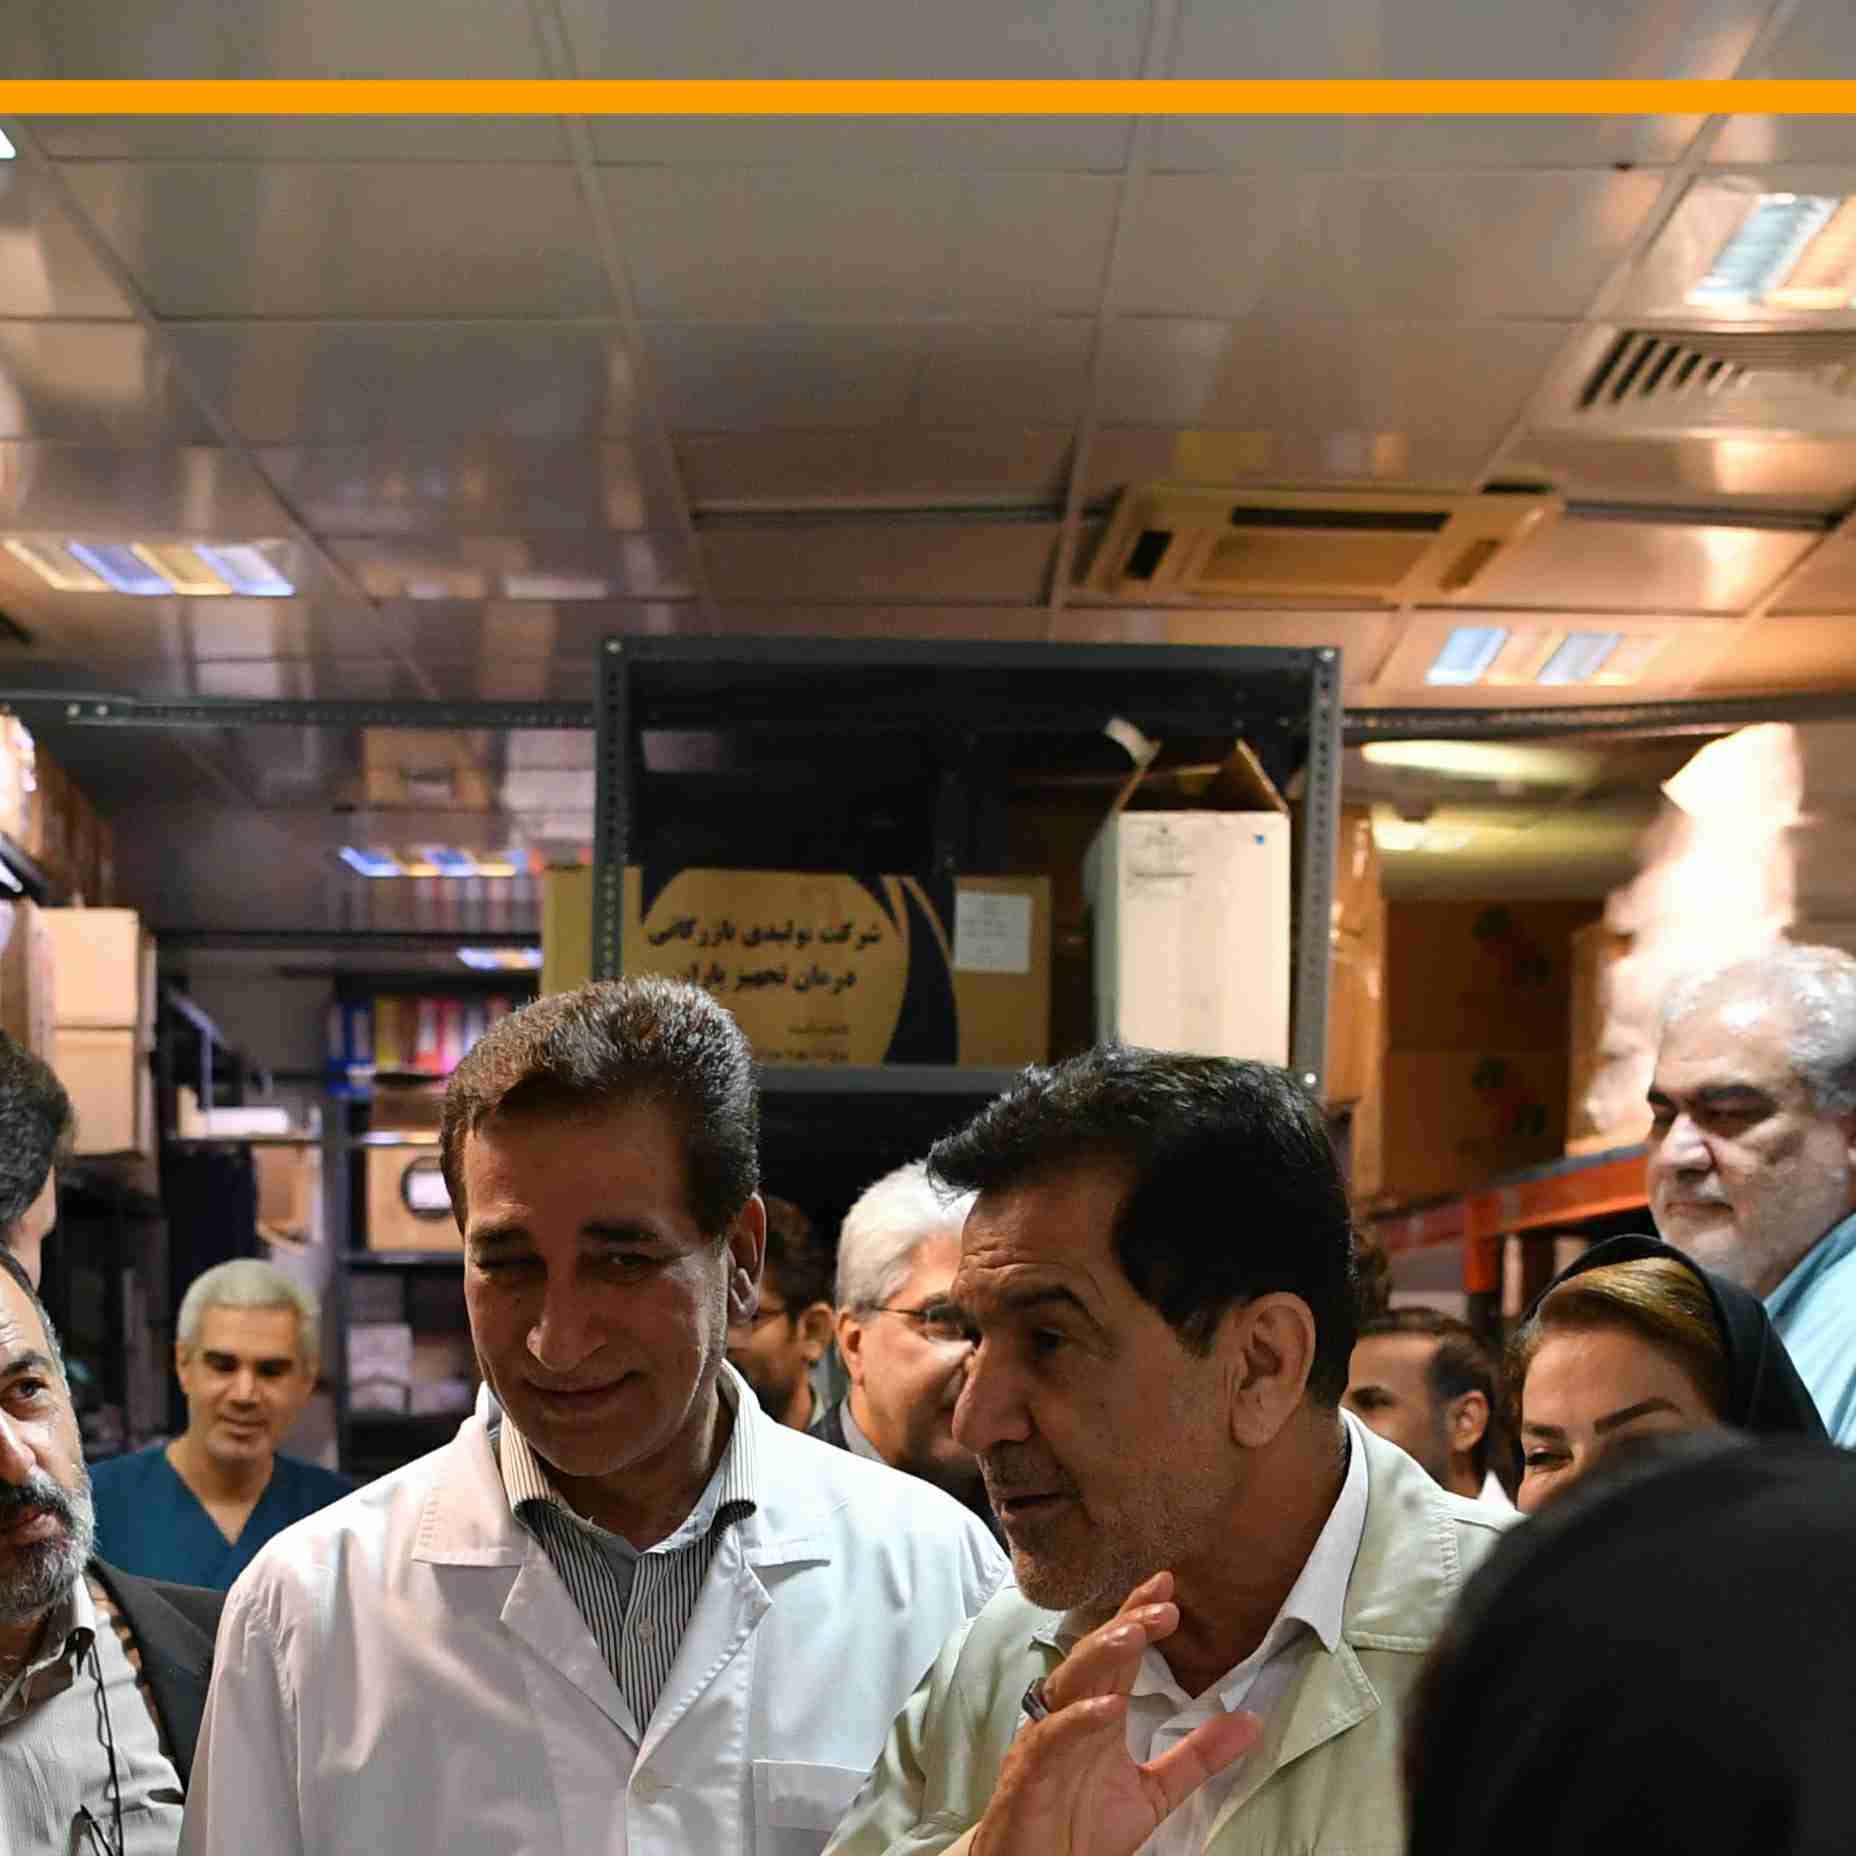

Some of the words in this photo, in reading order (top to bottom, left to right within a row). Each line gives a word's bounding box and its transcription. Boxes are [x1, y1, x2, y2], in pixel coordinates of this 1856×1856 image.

[645, 916, 737, 948] بازرگانی
[740, 918, 813, 949] تولیدی
[818, 918, 884, 949] شرکت
[793, 963, 857, 993] درمان
